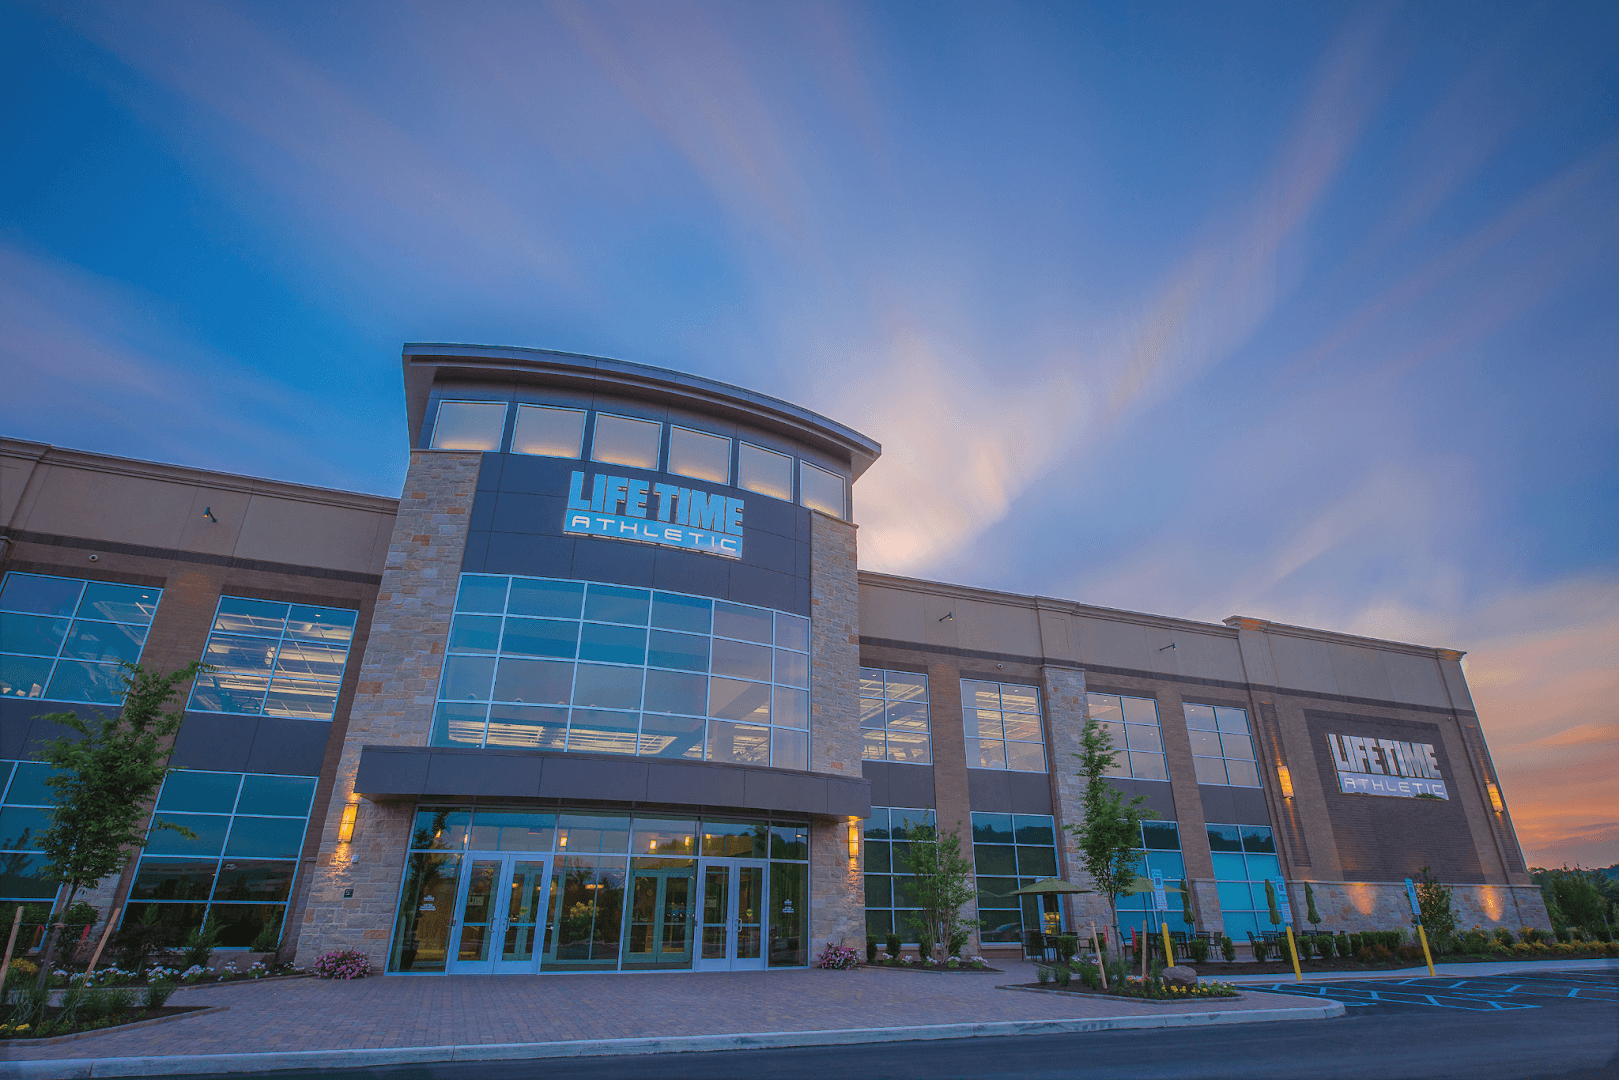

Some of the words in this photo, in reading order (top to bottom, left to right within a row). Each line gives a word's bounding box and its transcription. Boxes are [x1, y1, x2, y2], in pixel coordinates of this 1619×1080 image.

[567, 470, 650, 518] LIFE
[653, 482, 745, 537] TIME
[571, 515, 737, 552] ATHLETIC
[1327, 733, 1385, 774] LIFE
[1377, 738, 1443, 780] TIME
[1343, 777, 1445, 796] ATHLETIC
